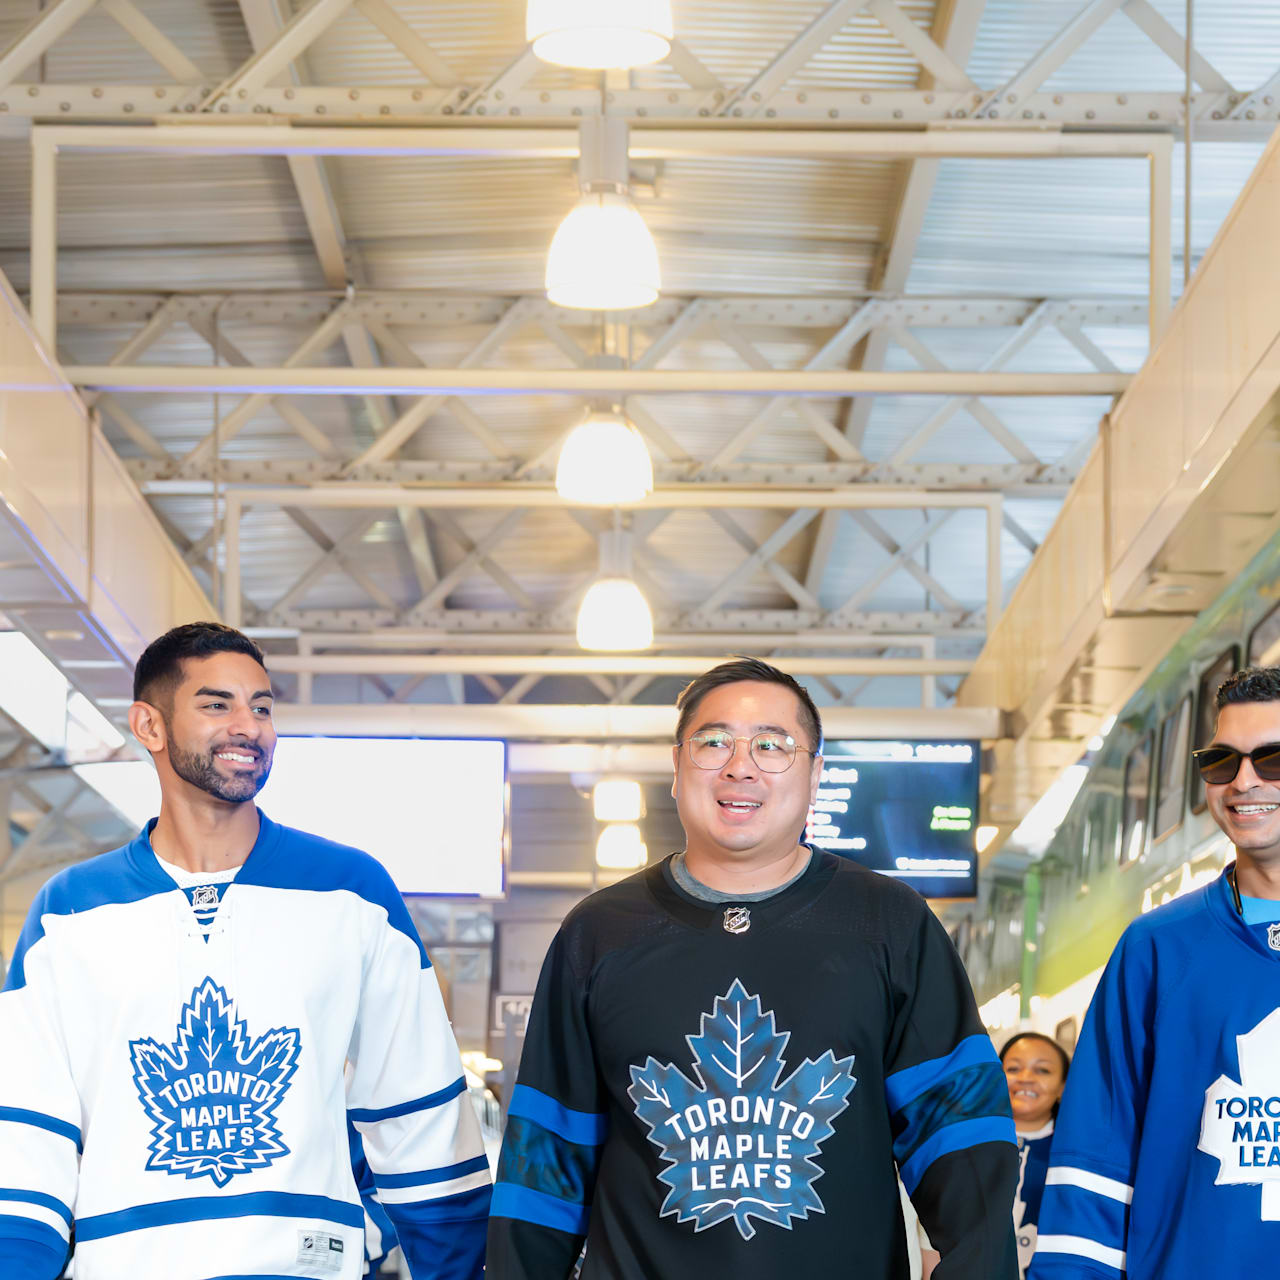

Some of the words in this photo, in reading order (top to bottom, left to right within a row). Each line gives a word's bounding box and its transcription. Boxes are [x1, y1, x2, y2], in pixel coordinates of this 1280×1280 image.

[158, 1070, 271, 1108] TORONTO
[180, 1103, 253, 1128] MAPLE
[664, 1095, 815, 1141] TORONTO
[176, 1126, 255, 1152] LEAFS
[690, 1134, 792, 1162] MAPLE
[691, 1163, 792, 1191] LEAFS
